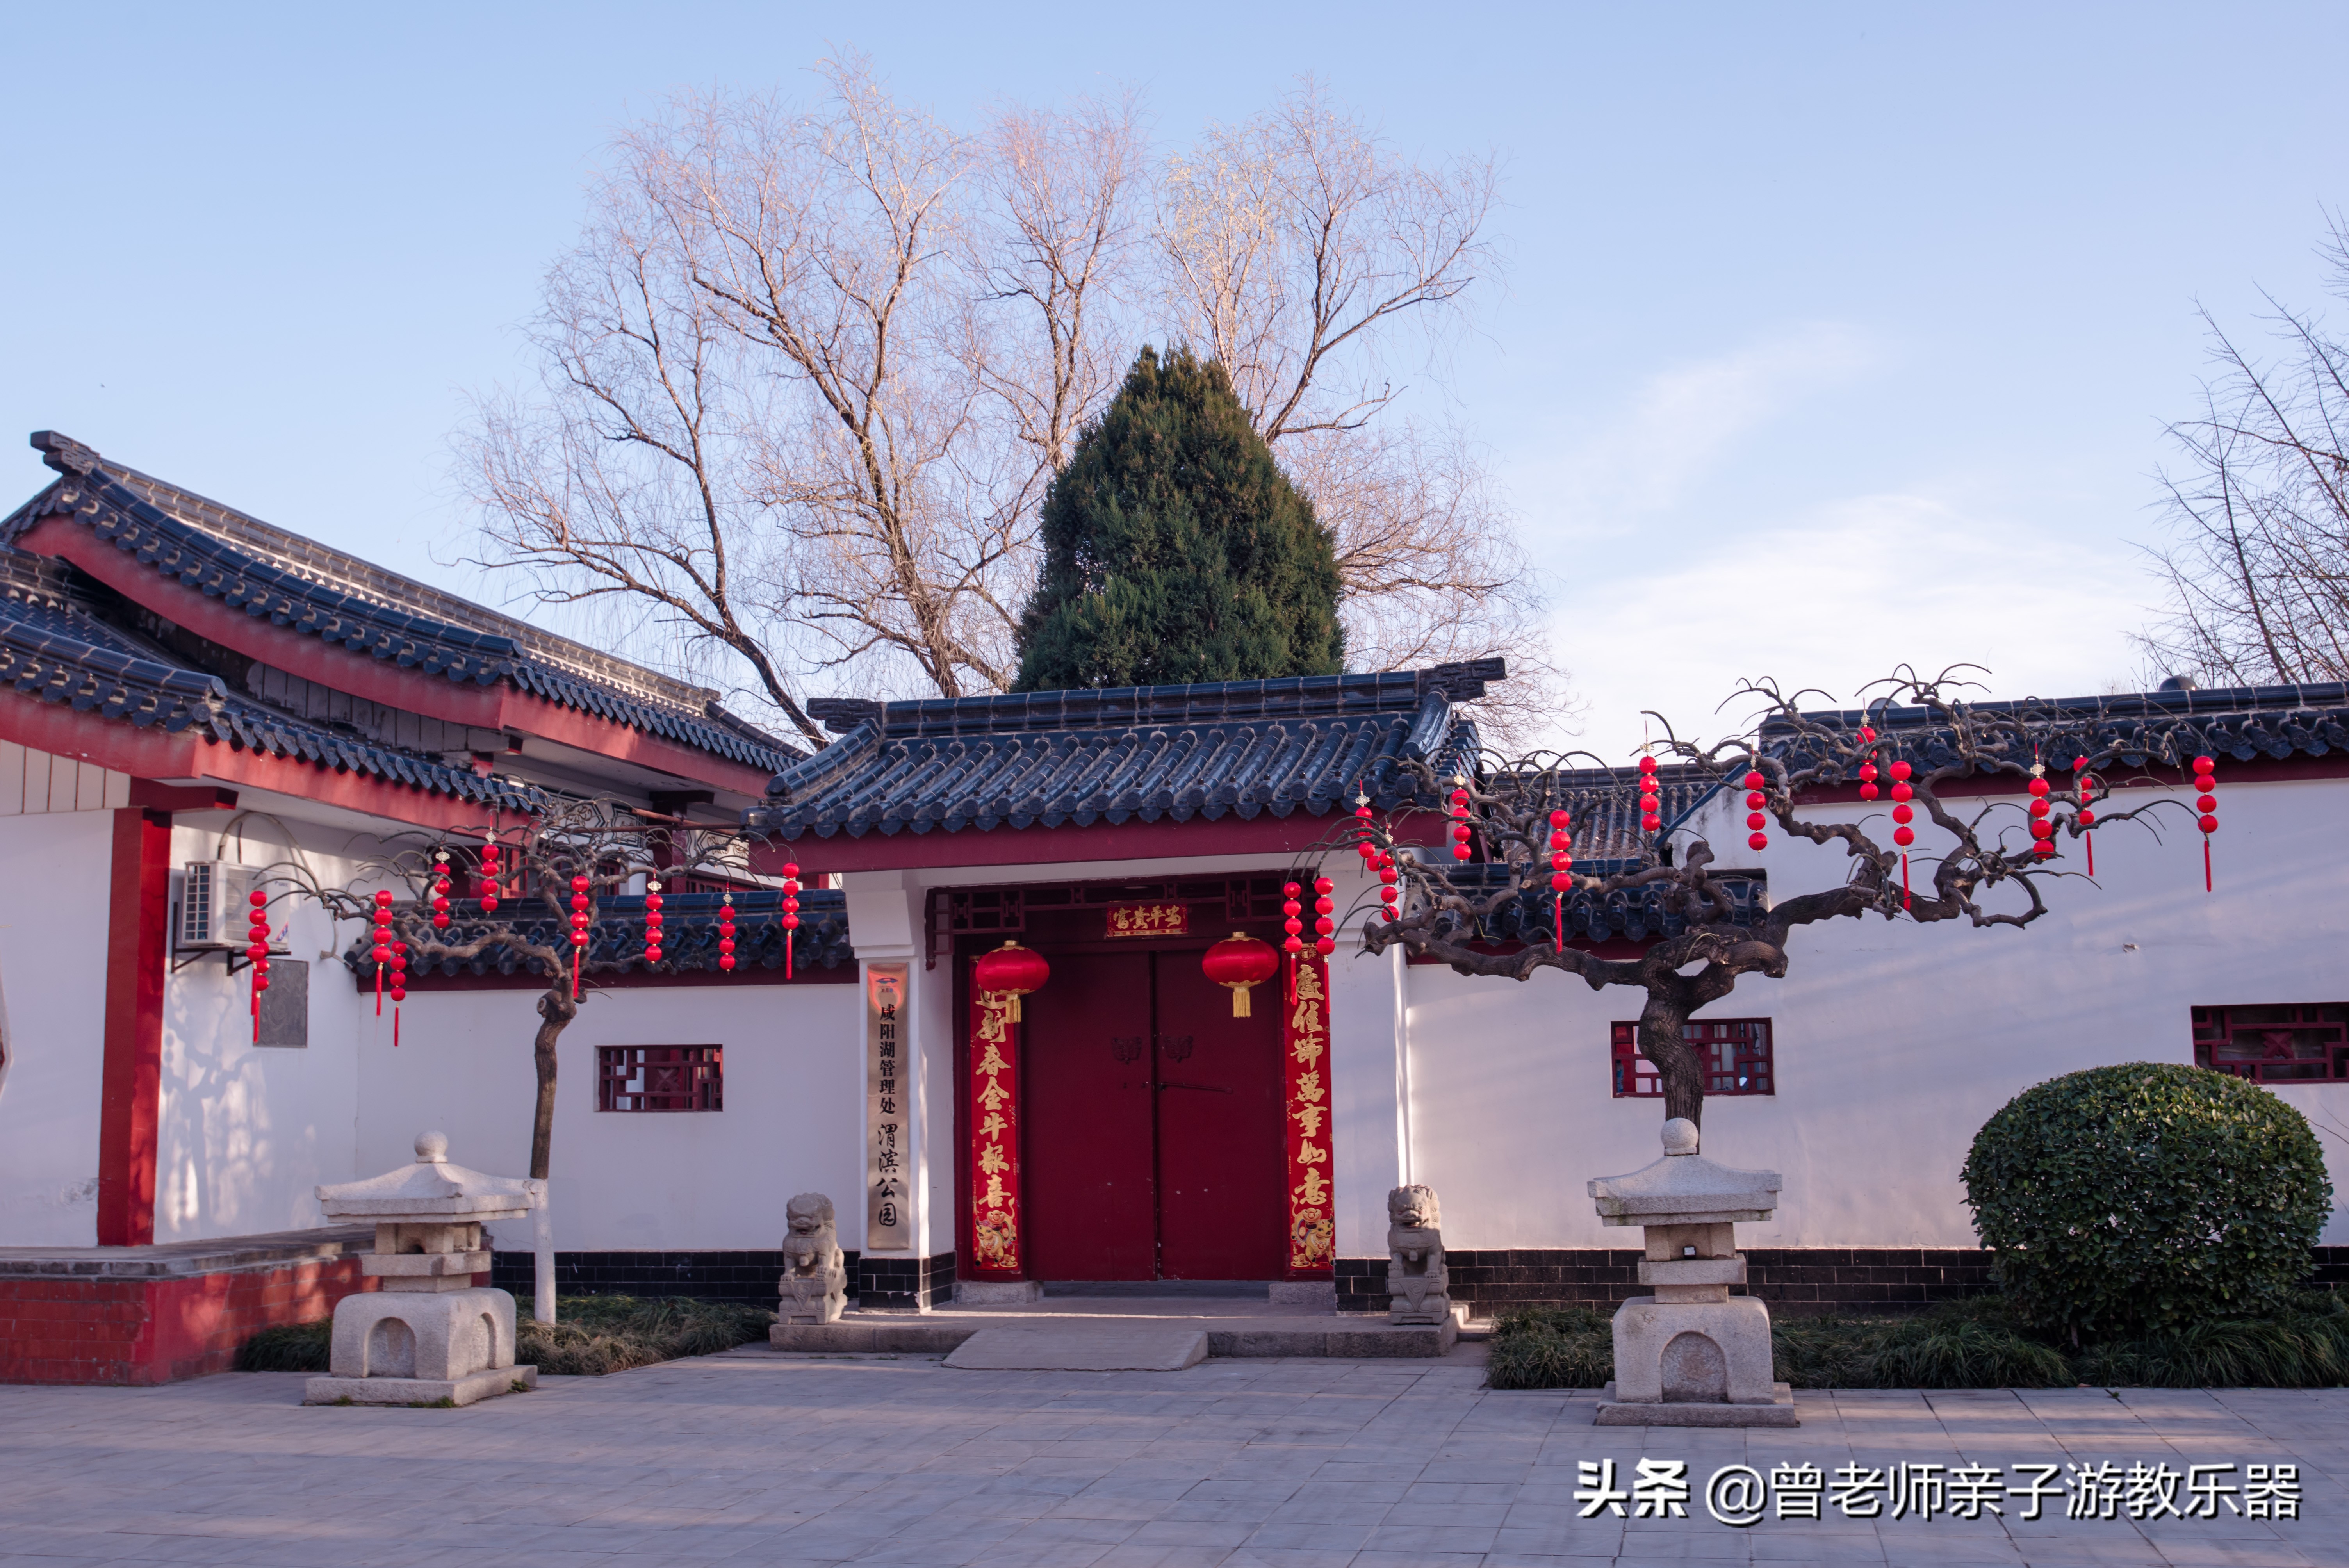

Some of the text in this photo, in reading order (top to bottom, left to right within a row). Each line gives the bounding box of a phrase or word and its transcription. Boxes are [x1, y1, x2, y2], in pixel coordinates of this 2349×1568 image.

[880, 1004, 895, 1114] 咸阳湖管理处
[876, 1124, 899, 1227] 渭滨公园
